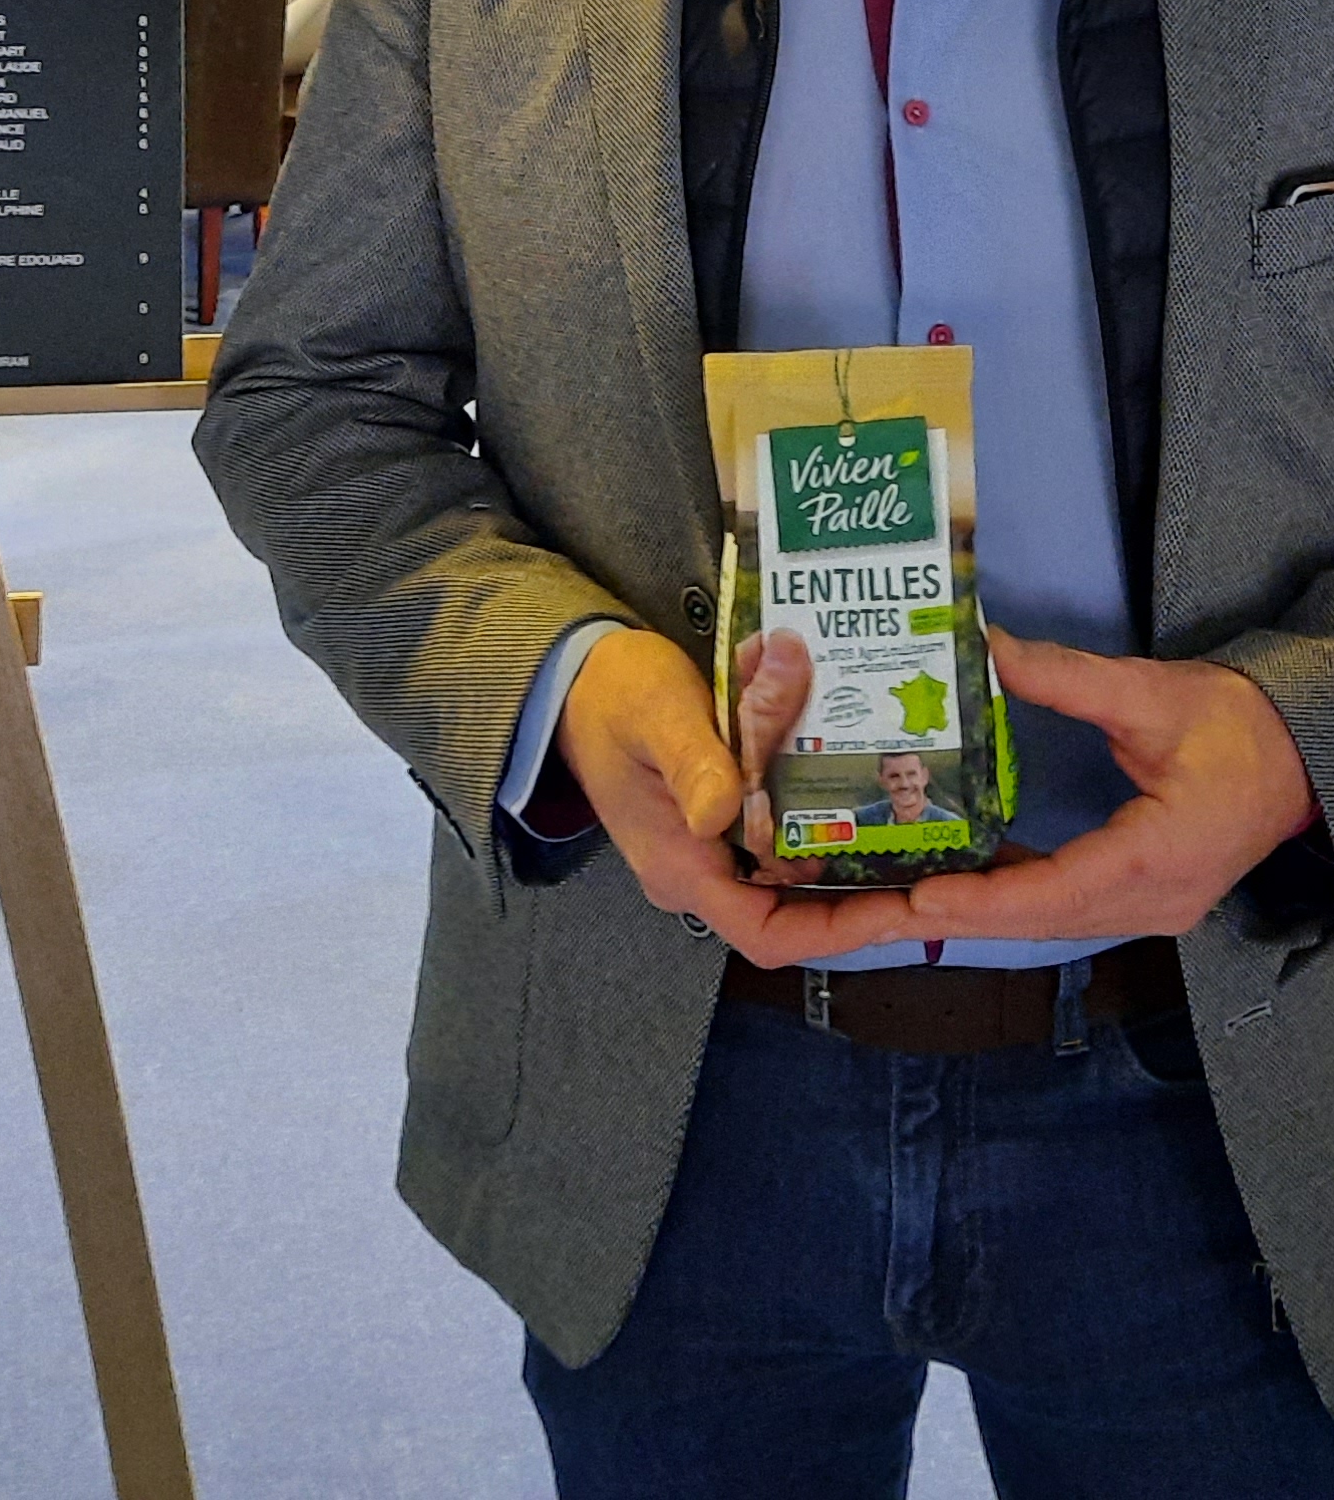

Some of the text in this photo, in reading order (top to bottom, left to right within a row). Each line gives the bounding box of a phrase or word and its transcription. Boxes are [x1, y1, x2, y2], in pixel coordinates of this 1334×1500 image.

[790, 445, 899, 493] Vivien
[798, 484, 913, 535] Paille
[771, 564, 941, 605] LENTILLES
[816, 608, 901, 638] VERTES
[787, 826, 800, 842] A
